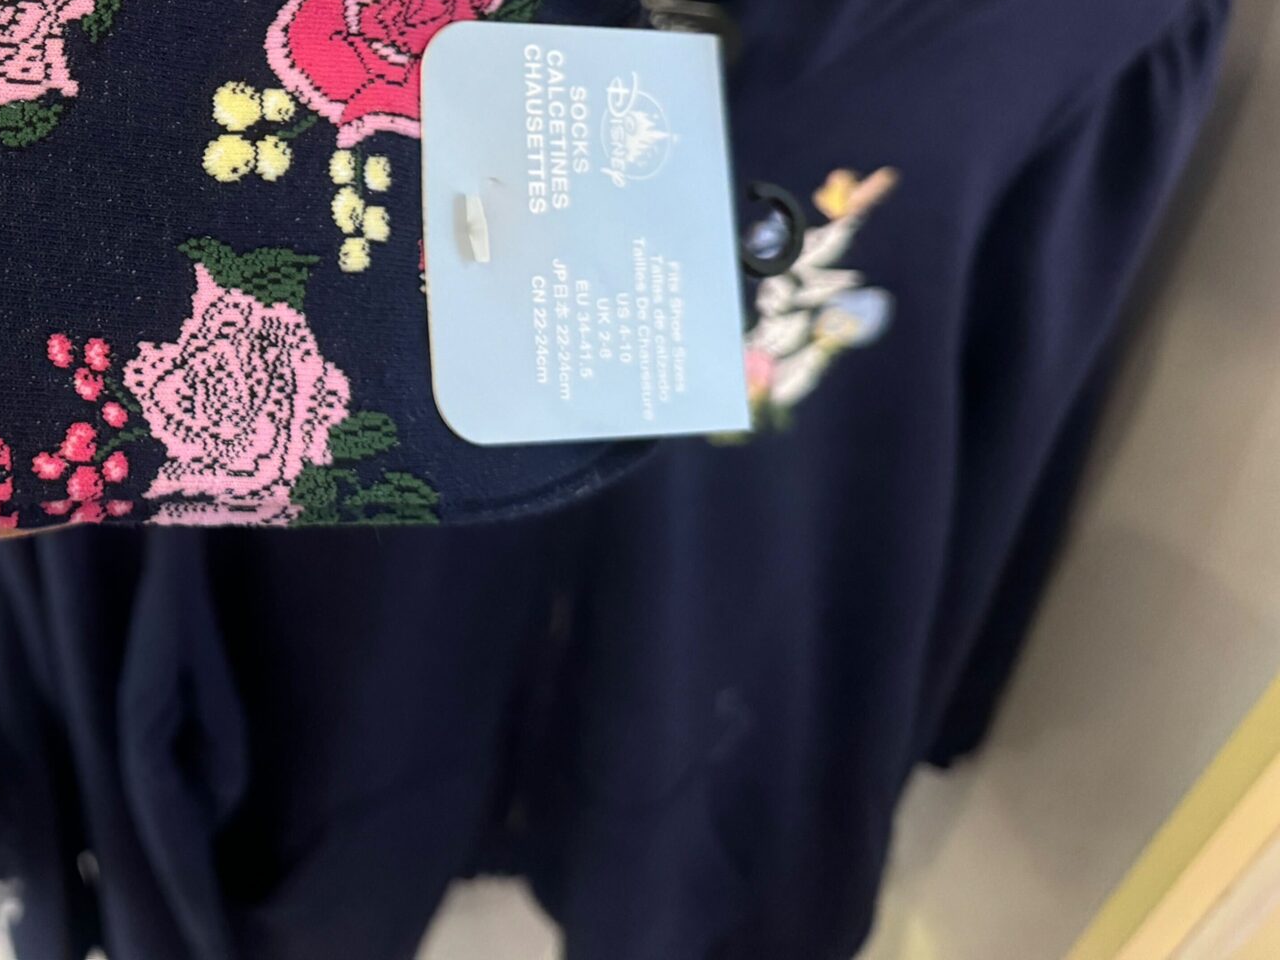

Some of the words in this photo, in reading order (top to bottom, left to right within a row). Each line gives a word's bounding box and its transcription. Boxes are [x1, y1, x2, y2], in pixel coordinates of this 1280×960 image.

[524, 44, 547, 214] CHAUSETTES
[546, 49, 569, 209] CALCETINES
[570, 86, 589, 173] SOCKS
[601, 71, 638, 188] Disney
[532, 276, 546, 303] CN
[632, 237, 647, 291] Tailles
[576, 280, 590, 307] EU
[597, 298, 611, 325] UK
[615, 292, 630, 320] US
[635, 297, 649, 320] De
[653, 308, 666, 330] de
[670, 297, 683, 341] Shoe
[534, 307, 549, 383] 22-24cm
[556, 325, 571, 400] 22-24cm
[577, 312, 593, 379] 34-41.5
[617, 324, 632, 364] 4-10
[655, 334, 669, 402] calzado
[673, 347, 686, 392] Sizes
[638, 326, 655, 421] Chaussure
